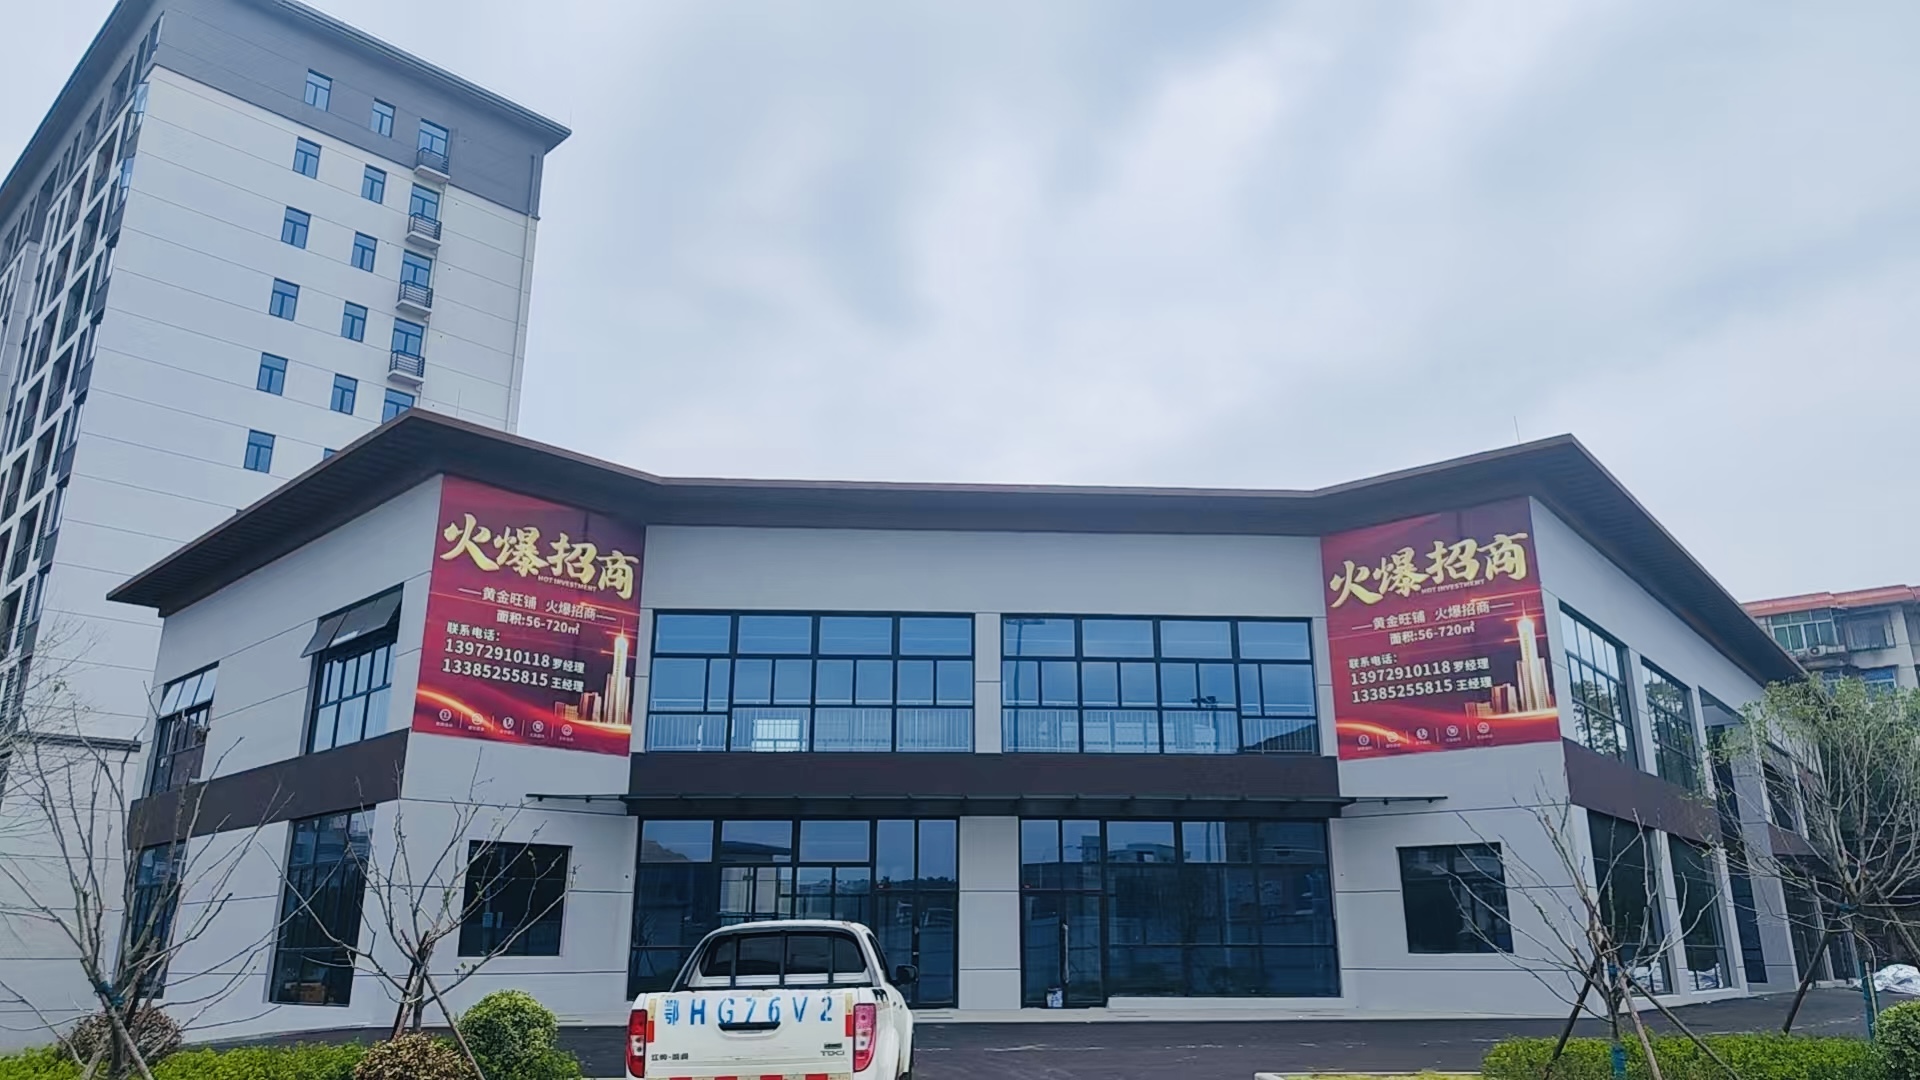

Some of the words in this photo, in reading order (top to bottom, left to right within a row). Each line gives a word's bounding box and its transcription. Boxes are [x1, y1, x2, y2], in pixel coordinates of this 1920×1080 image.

[440, 513, 640, 600] 火爆招商
[1329, 532, 1529, 608] 火爆招商
[538, 575, 553, 583] HOT
[553, 578, 597, 592] INVESTMENT
[1421, 586, 1436, 594] HOT
[1437, 578, 1485, 592] INVESTMENT
[482, 586, 537, 610] 黄金旺铺
[545, 600, 597, 621] 火爆招商
[1372, 610, 1426, 631] 黄金旺铺
[1434, 600, 1490, 621] 火爆招商
[444, 638, 550, 668] 13972910118
[552, 658, 585, 674] 罗经理
[1351, 660, 1451, 686] 13972910118
[1453, 657, 1490, 673] 罗经理
[442, 658, 549, 687] 13385255815
[551, 676, 584, 693] 王经理
[1352, 679, 1453, 704] 13385255815
[1455, 676, 1493, 692] 王经理
